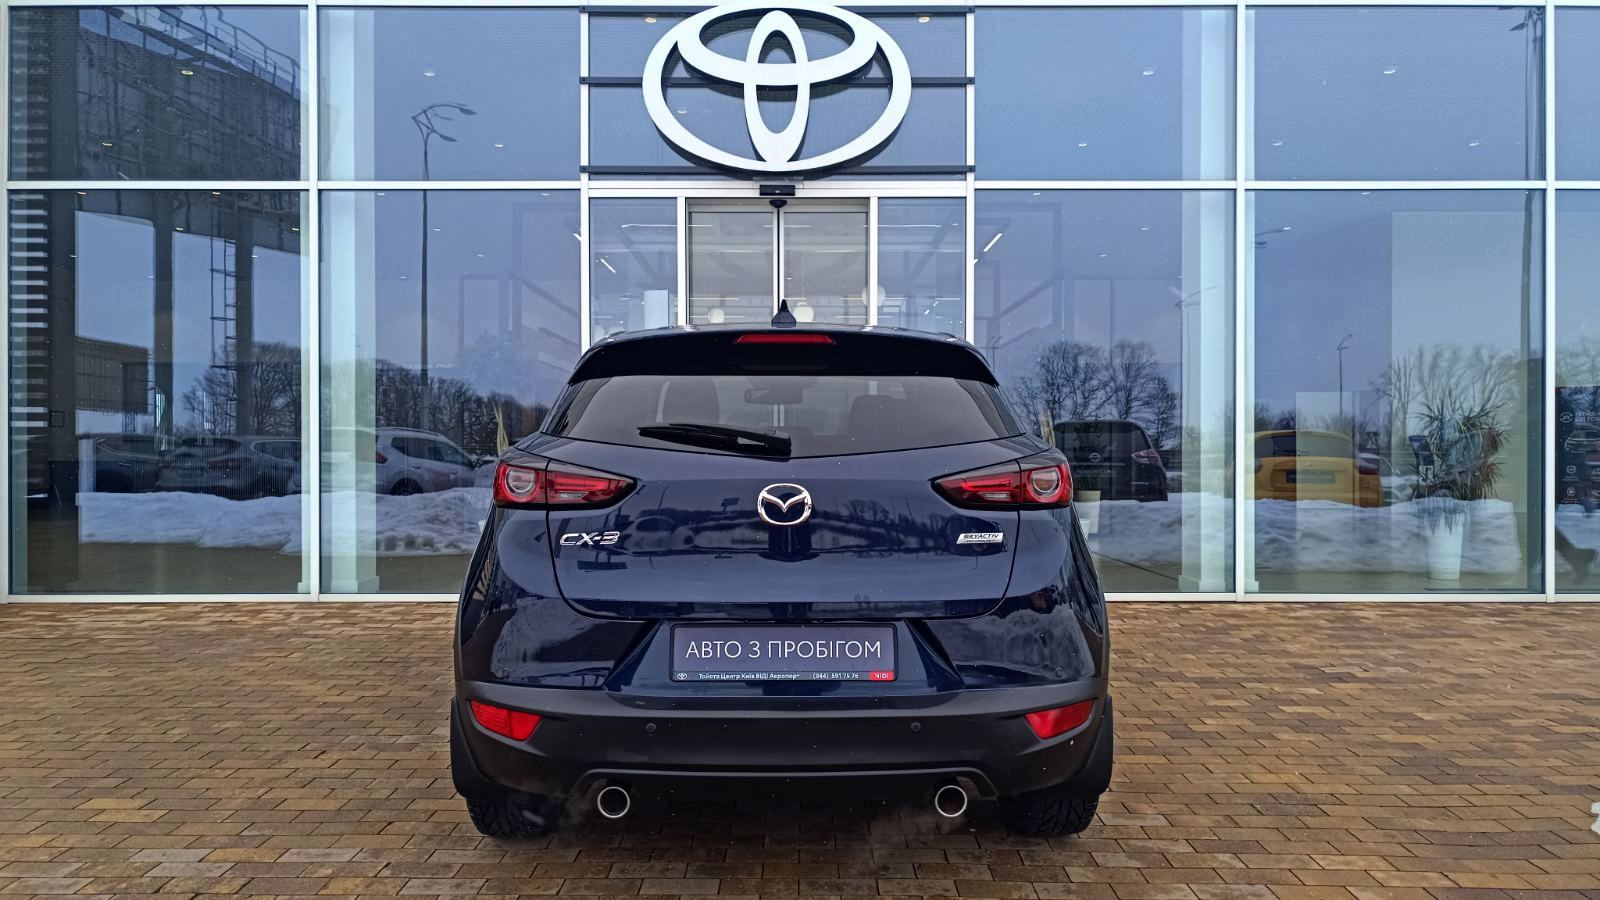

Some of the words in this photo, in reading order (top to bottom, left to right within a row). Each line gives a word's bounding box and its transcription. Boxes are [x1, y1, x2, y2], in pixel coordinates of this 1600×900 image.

[560, 531, 620, 546] CX-3
[685, 640, 742, 659] АВТО
[748, 640, 761, 659] З
[767, 640, 882, 659] ПРОБІГОМ
[721, 673, 741, 681] Центр
[769, 673, 800, 681] Аеропорт
[812, 672, 829, 680] (044)
